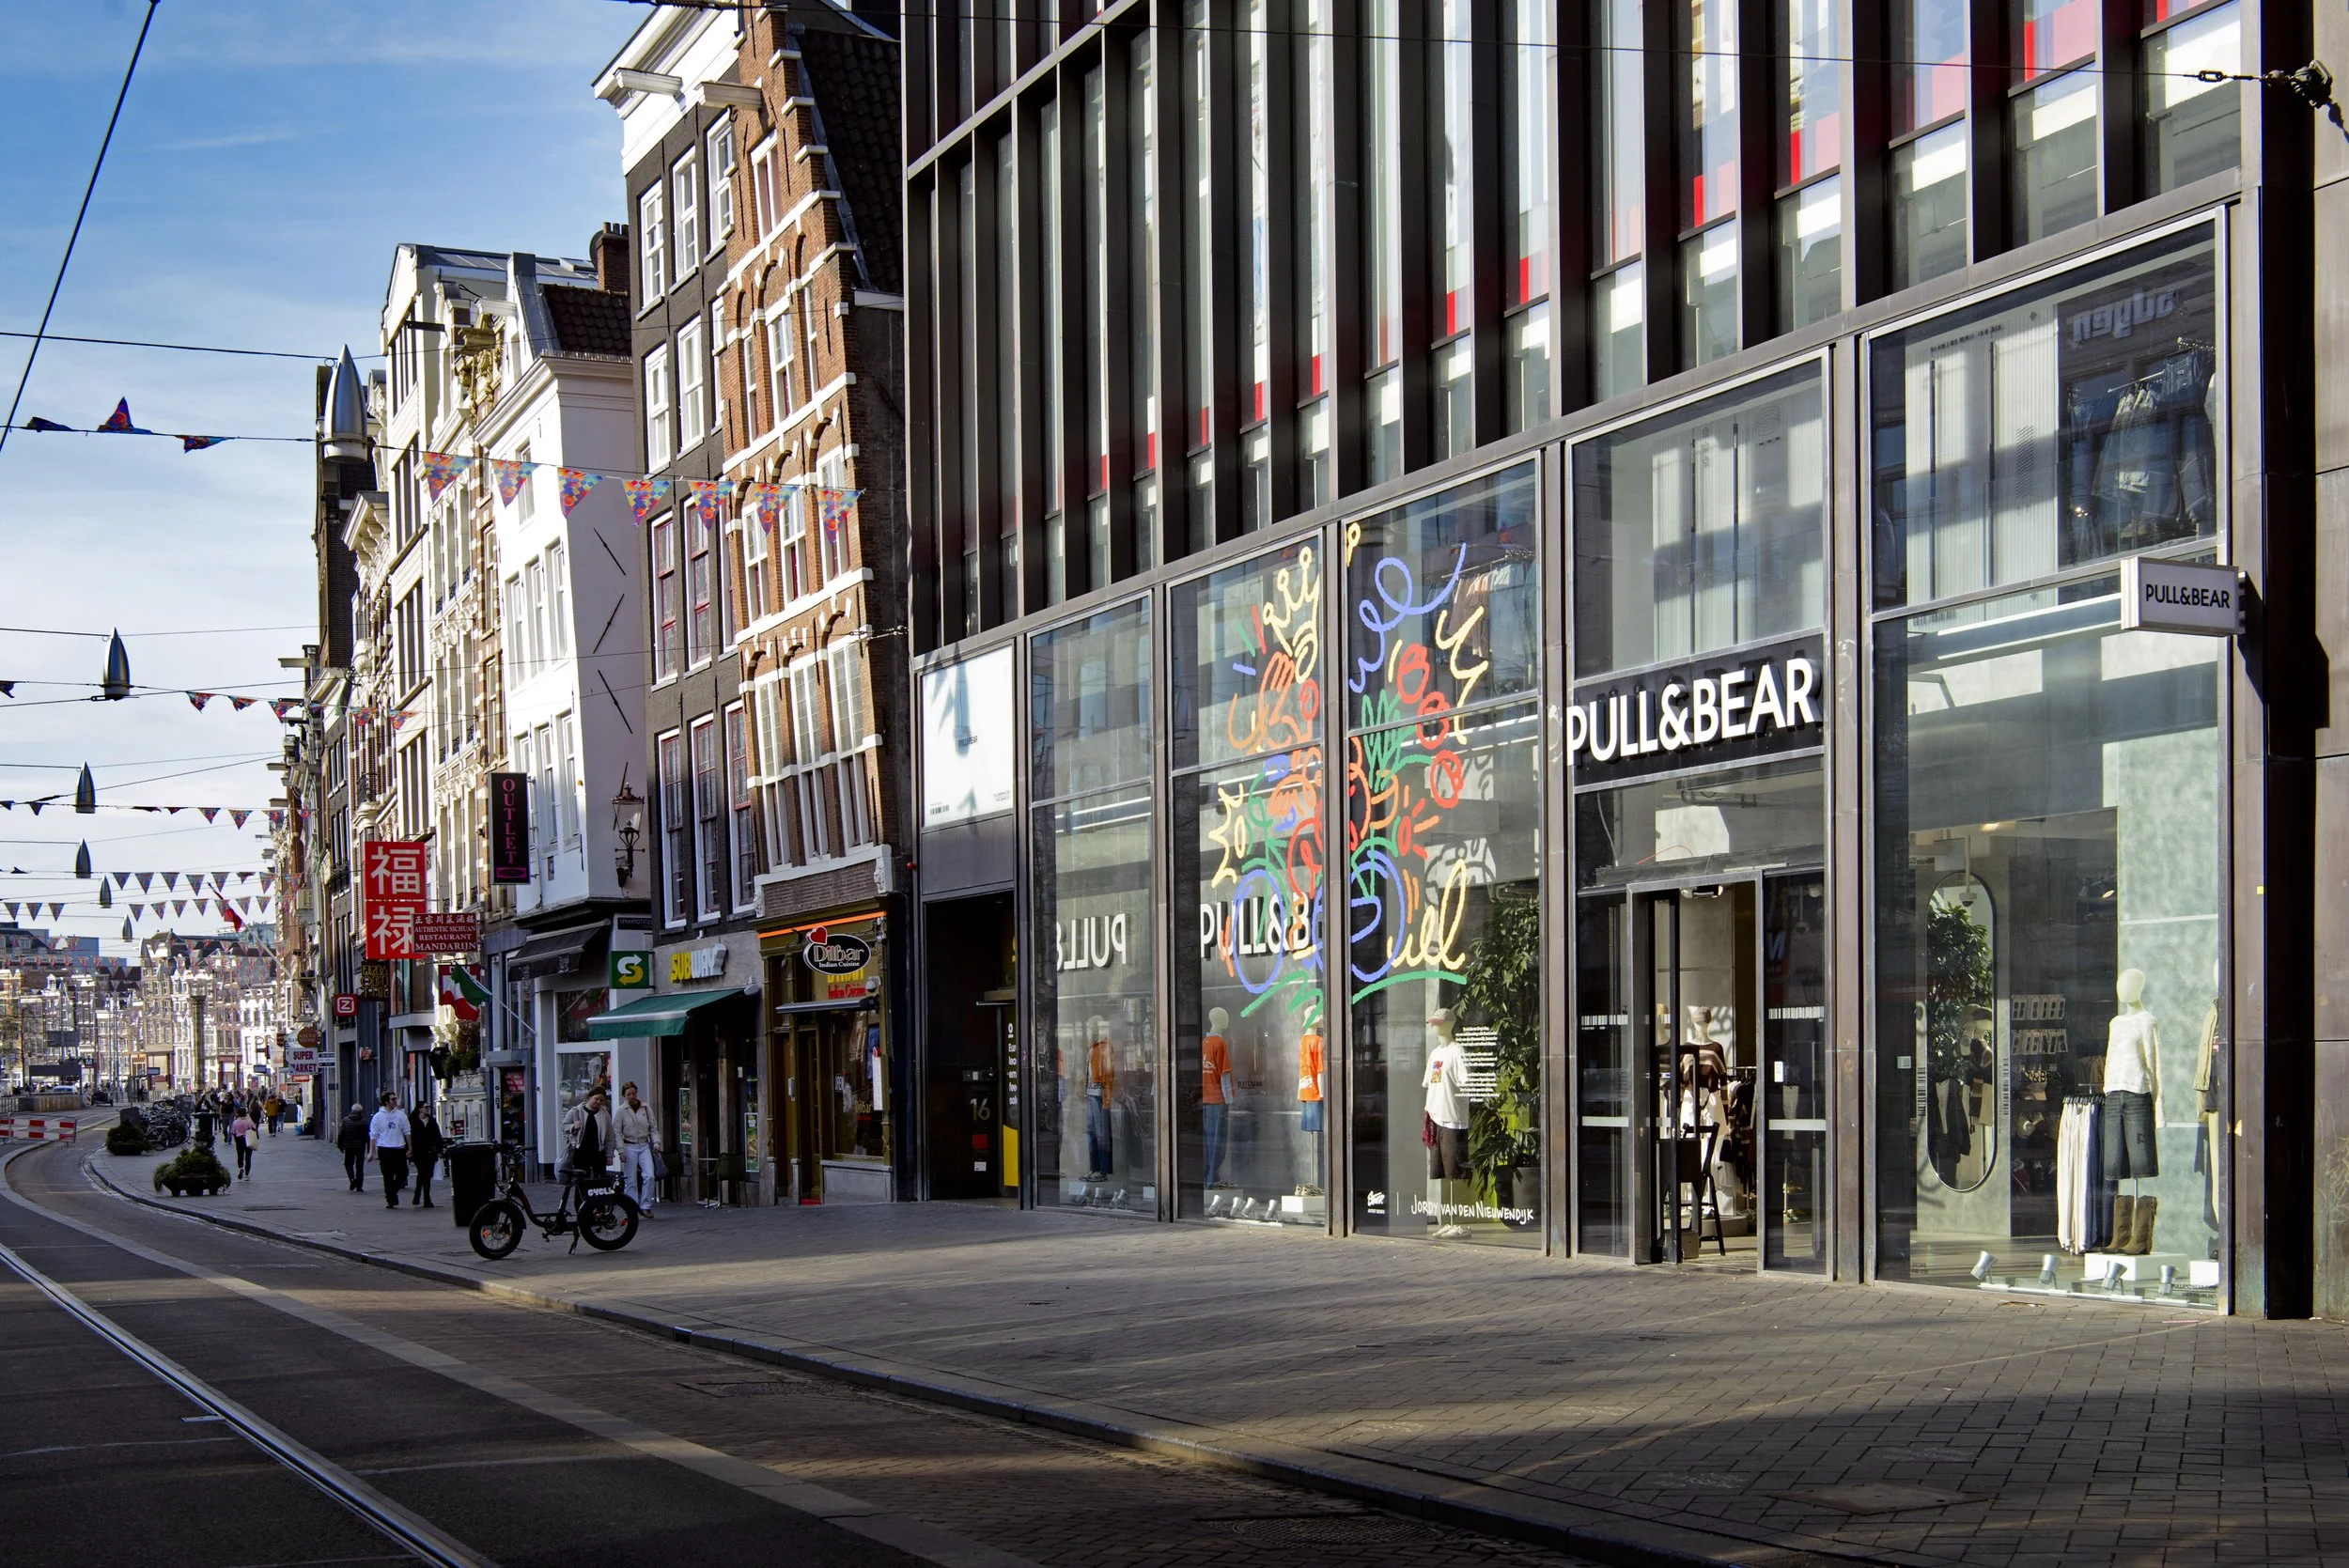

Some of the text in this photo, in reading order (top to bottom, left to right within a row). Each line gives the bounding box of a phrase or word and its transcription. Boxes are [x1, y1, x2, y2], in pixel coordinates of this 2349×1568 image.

[2145, 583, 2231, 609] PULL&BEAR
[1566, 657, 1818, 767] PULL&BEAR
[502, 779, 517, 863] OUTLET
[414, 941, 476, 951] MANDARIJN
[418, 933, 473, 941] RESTAURANT
[669, 943, 727, 984] SUBWAY
[813, 944, 864, 963] Dilbar
[292, 1050, 314, 1061] SUPER
[970, 1098, 990, 1121] 16
[1410, 1194, 1439, 1216] JORDY
[1440, 1203, 1457, 1216] VAN
[1458, 1204, 1475, 1218] DEN
